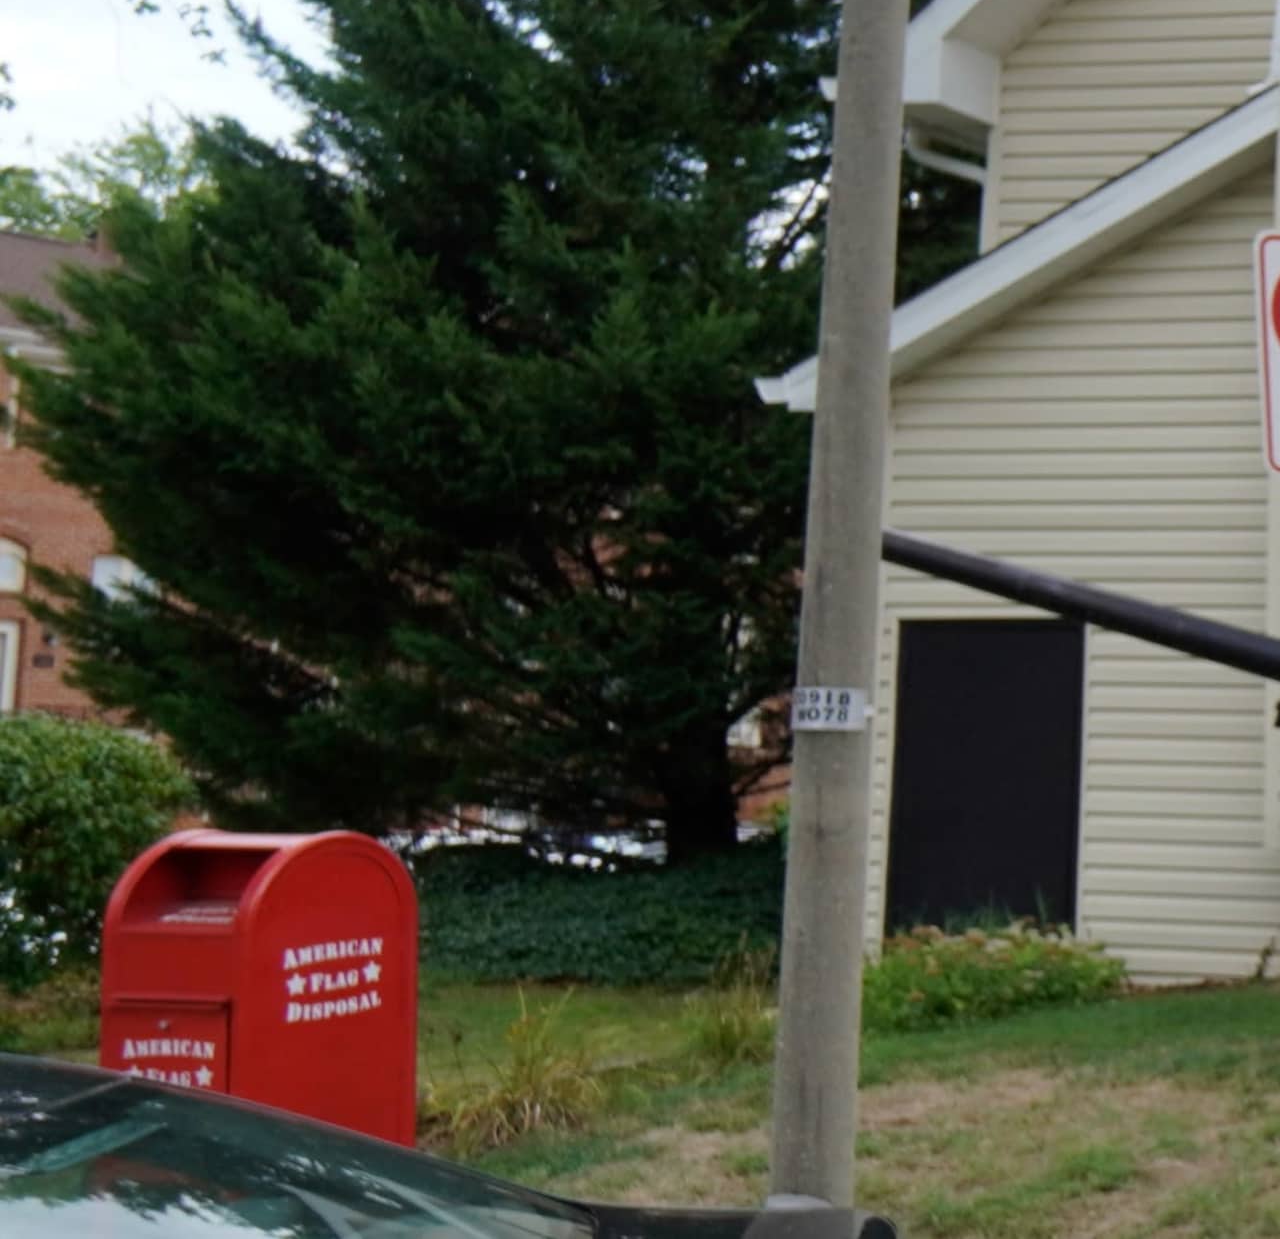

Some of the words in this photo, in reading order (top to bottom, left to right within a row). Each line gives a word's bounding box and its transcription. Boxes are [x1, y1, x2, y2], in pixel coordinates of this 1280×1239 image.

[283, 937, 383, 970] AMERICAN
[310, 969, 359, 993] FLAG
[286, 989, 382, 1024] DISPOSAL
[122, 1038, 215, 1059] AMERICAN
